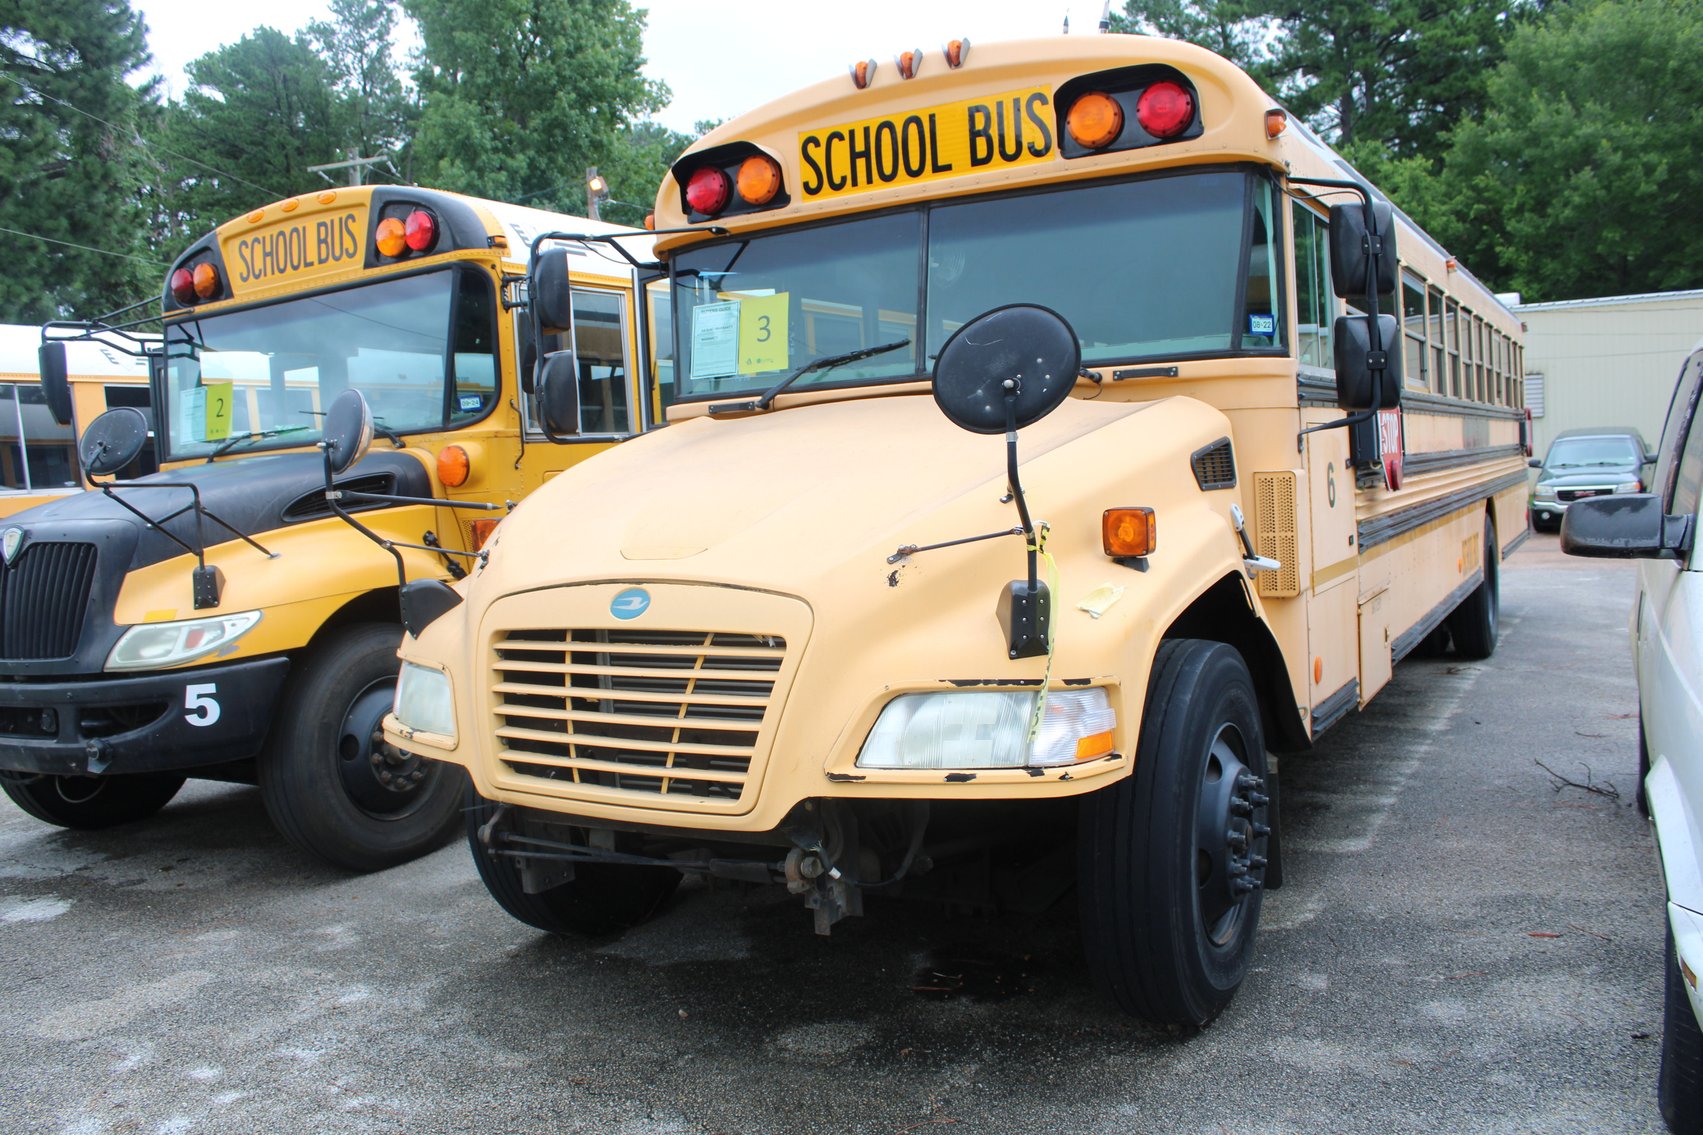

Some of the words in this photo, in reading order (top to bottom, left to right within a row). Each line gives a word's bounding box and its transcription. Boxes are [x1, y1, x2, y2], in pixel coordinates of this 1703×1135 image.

[801, 113, 953, 196] SCHOOL
[967, 92, 1053, 167] BUS
[238, 225, 314, 282] SCHOOL
[316, 213, 358, 265] BUS
[756, 315, 771, 342] 3
[216, 398, 224, 418] 2
[1381, 412, 1399, 455] STOP
[1327, 461, 1336, 509] 6
[184, 683, 221, 727] 5
